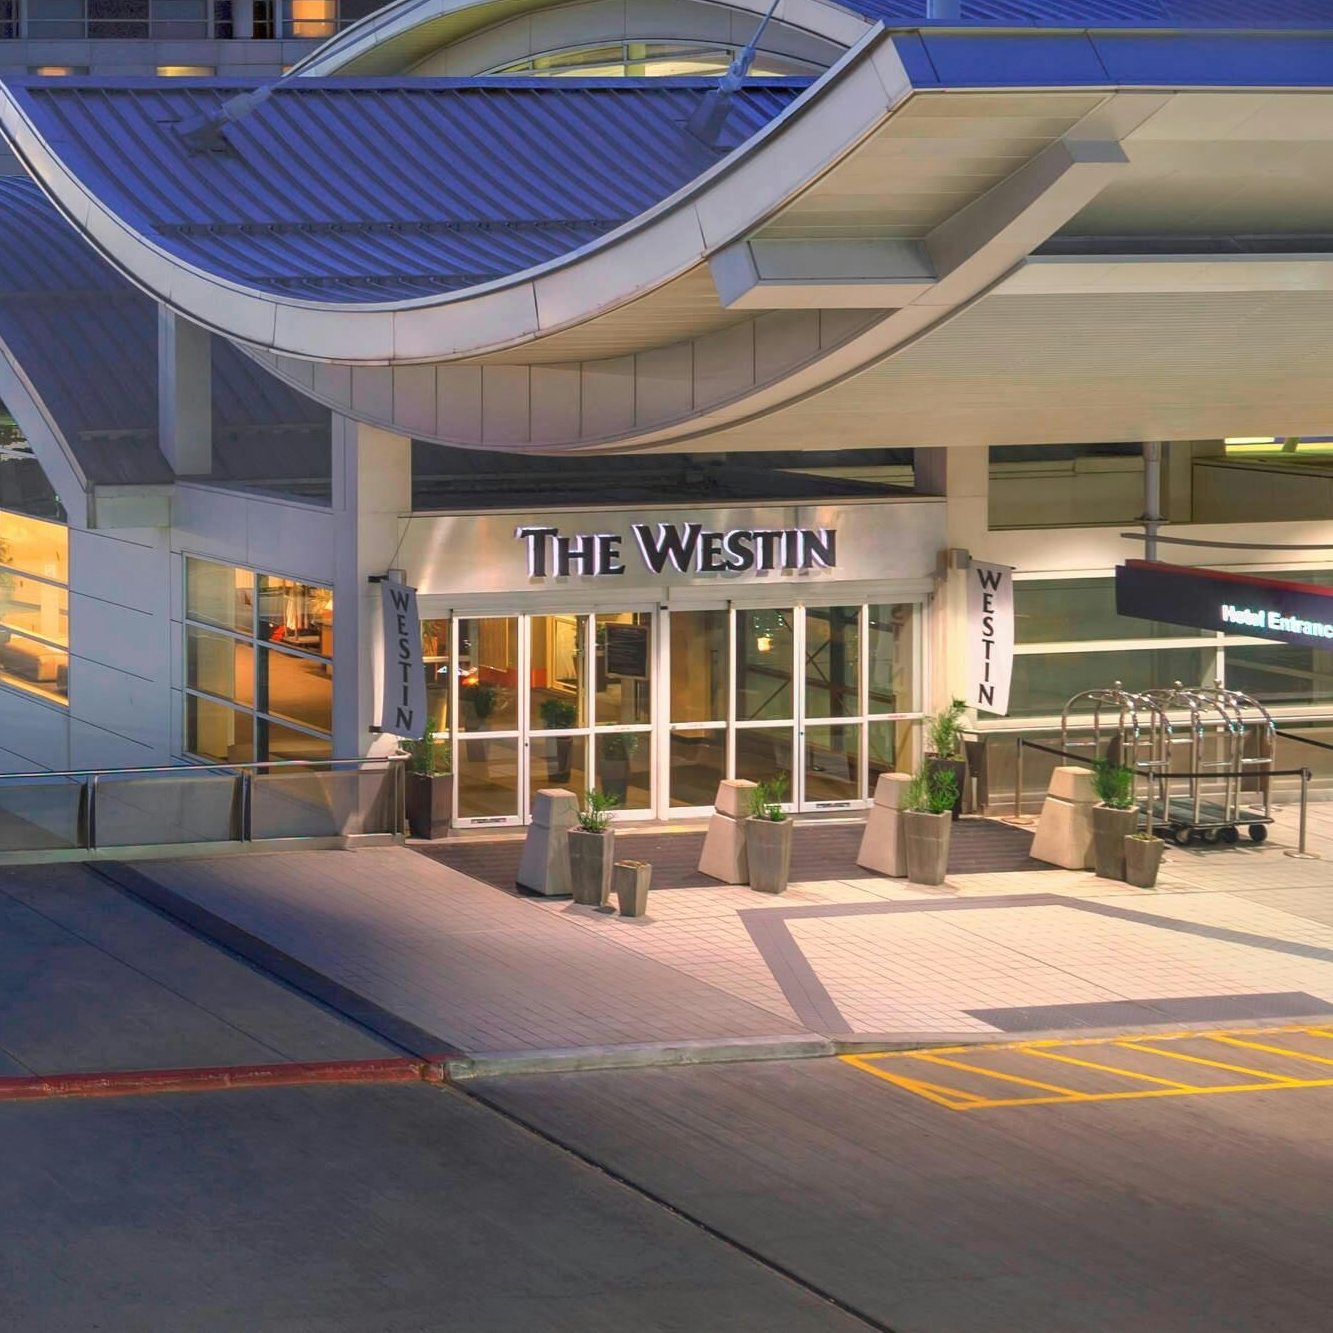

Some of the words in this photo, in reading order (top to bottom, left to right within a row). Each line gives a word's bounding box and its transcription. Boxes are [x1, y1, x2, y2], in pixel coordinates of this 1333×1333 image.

[515, 525, 625, 577] THE
[632, 521, 837, 575] WESTIN
[390, 589, 414, 732] WESTIN
[977, 568, 1002, 707] WESTIN
[1221, 604, 1265, 628] Hotel
